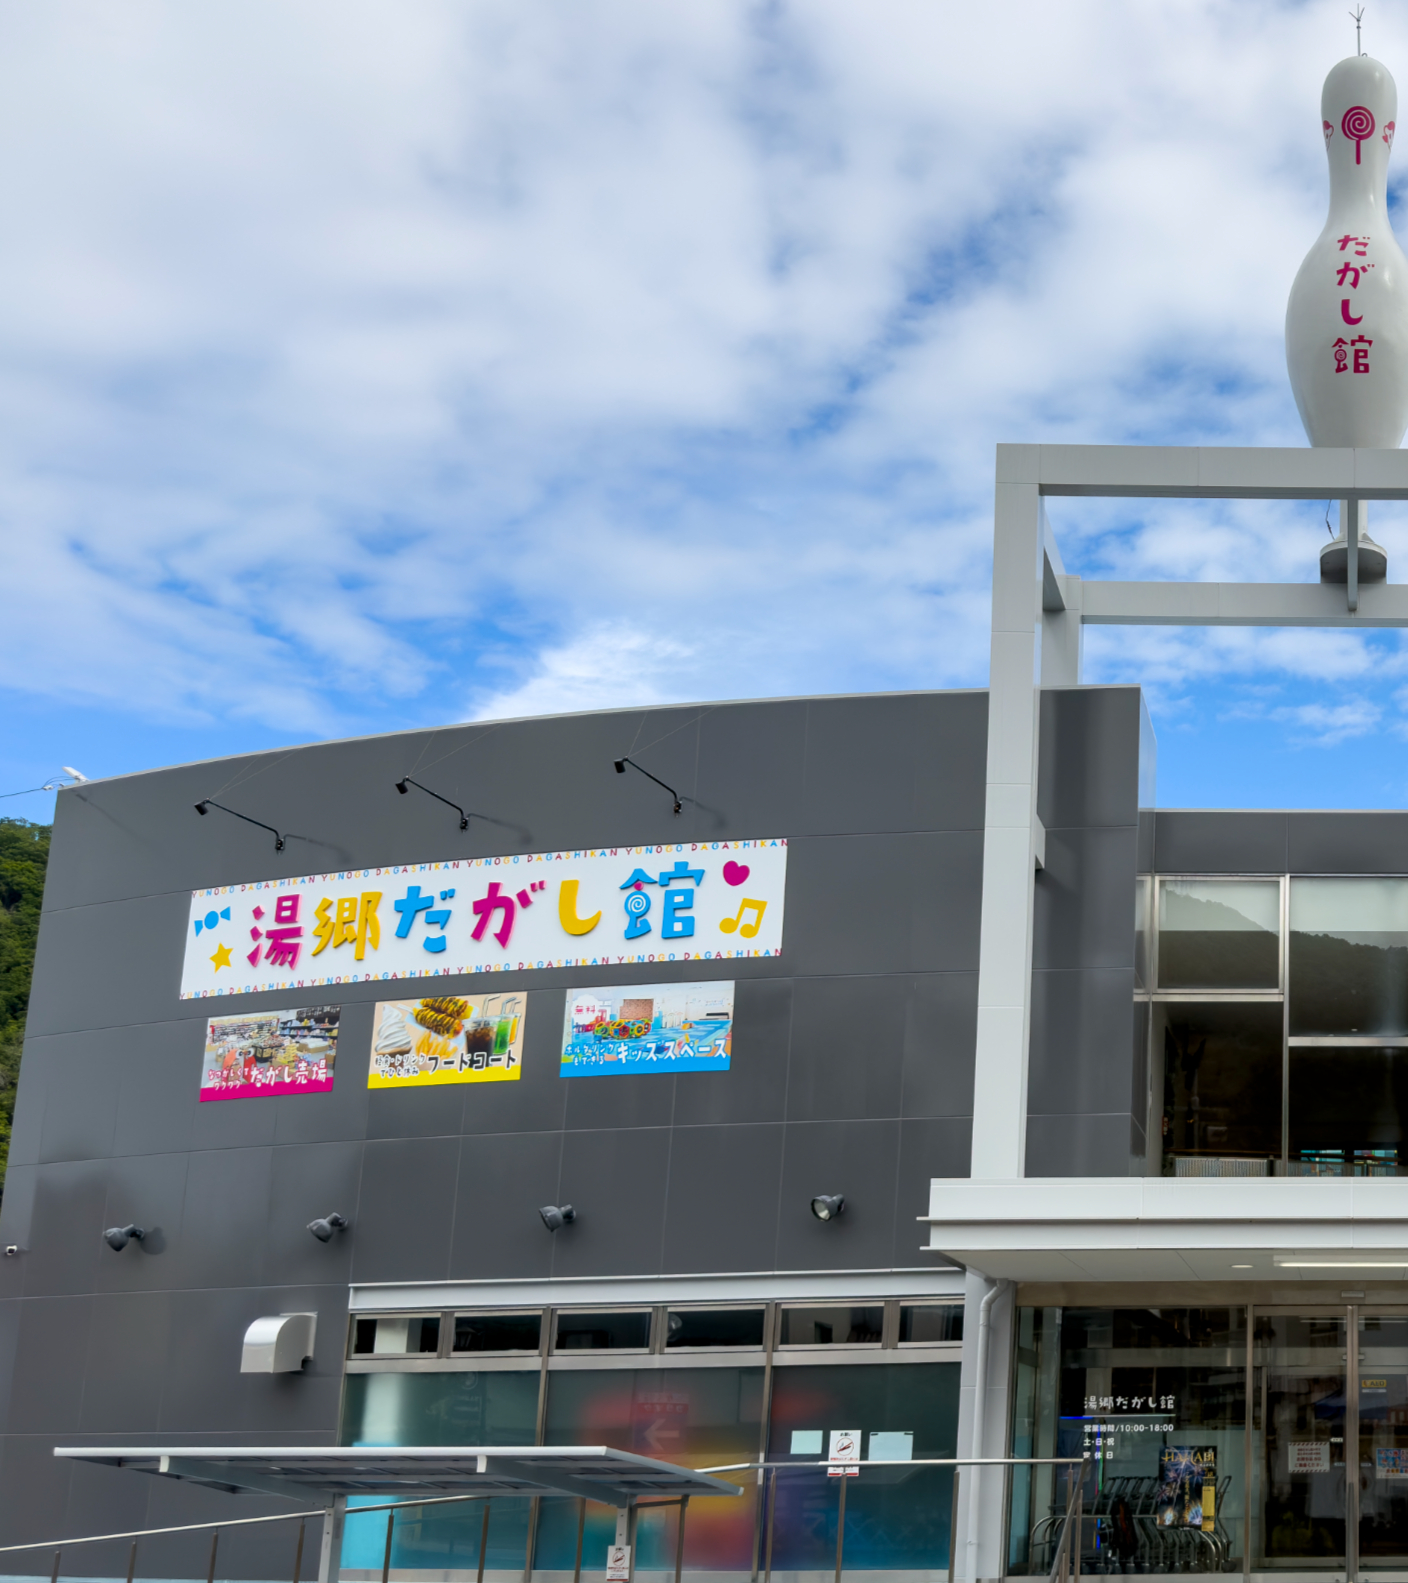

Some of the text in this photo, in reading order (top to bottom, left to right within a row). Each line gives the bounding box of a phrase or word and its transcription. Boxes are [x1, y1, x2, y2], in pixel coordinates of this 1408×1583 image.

[1332, 234, 1376, 375] だがし館
[191, 839, 788, 899] YUNOGO DAGASHIKAN YUNOGO DAGASHIKAN YUNOGO DAGASHIKAN YUNOGO DAGASHIKAN
[246, 860, 706, 971] 湯郷だがし館
[179, 948, 783, 1000] YUNOGO DAGASHIKAN YUNOGO DAGASHIKAN YUNOGO DAGASHIKAN YUNOGO DAGASHIKAN
[574, 1004, 596, 1015] 無料
[427, 1049, 517, 1074] フードコート
[618, 1039, 728, 1064] キッズスペース
[250, 1058, 328, 1088] だがし売場
[1084, 1394, 1176, 1410] 湯郷だがし館
